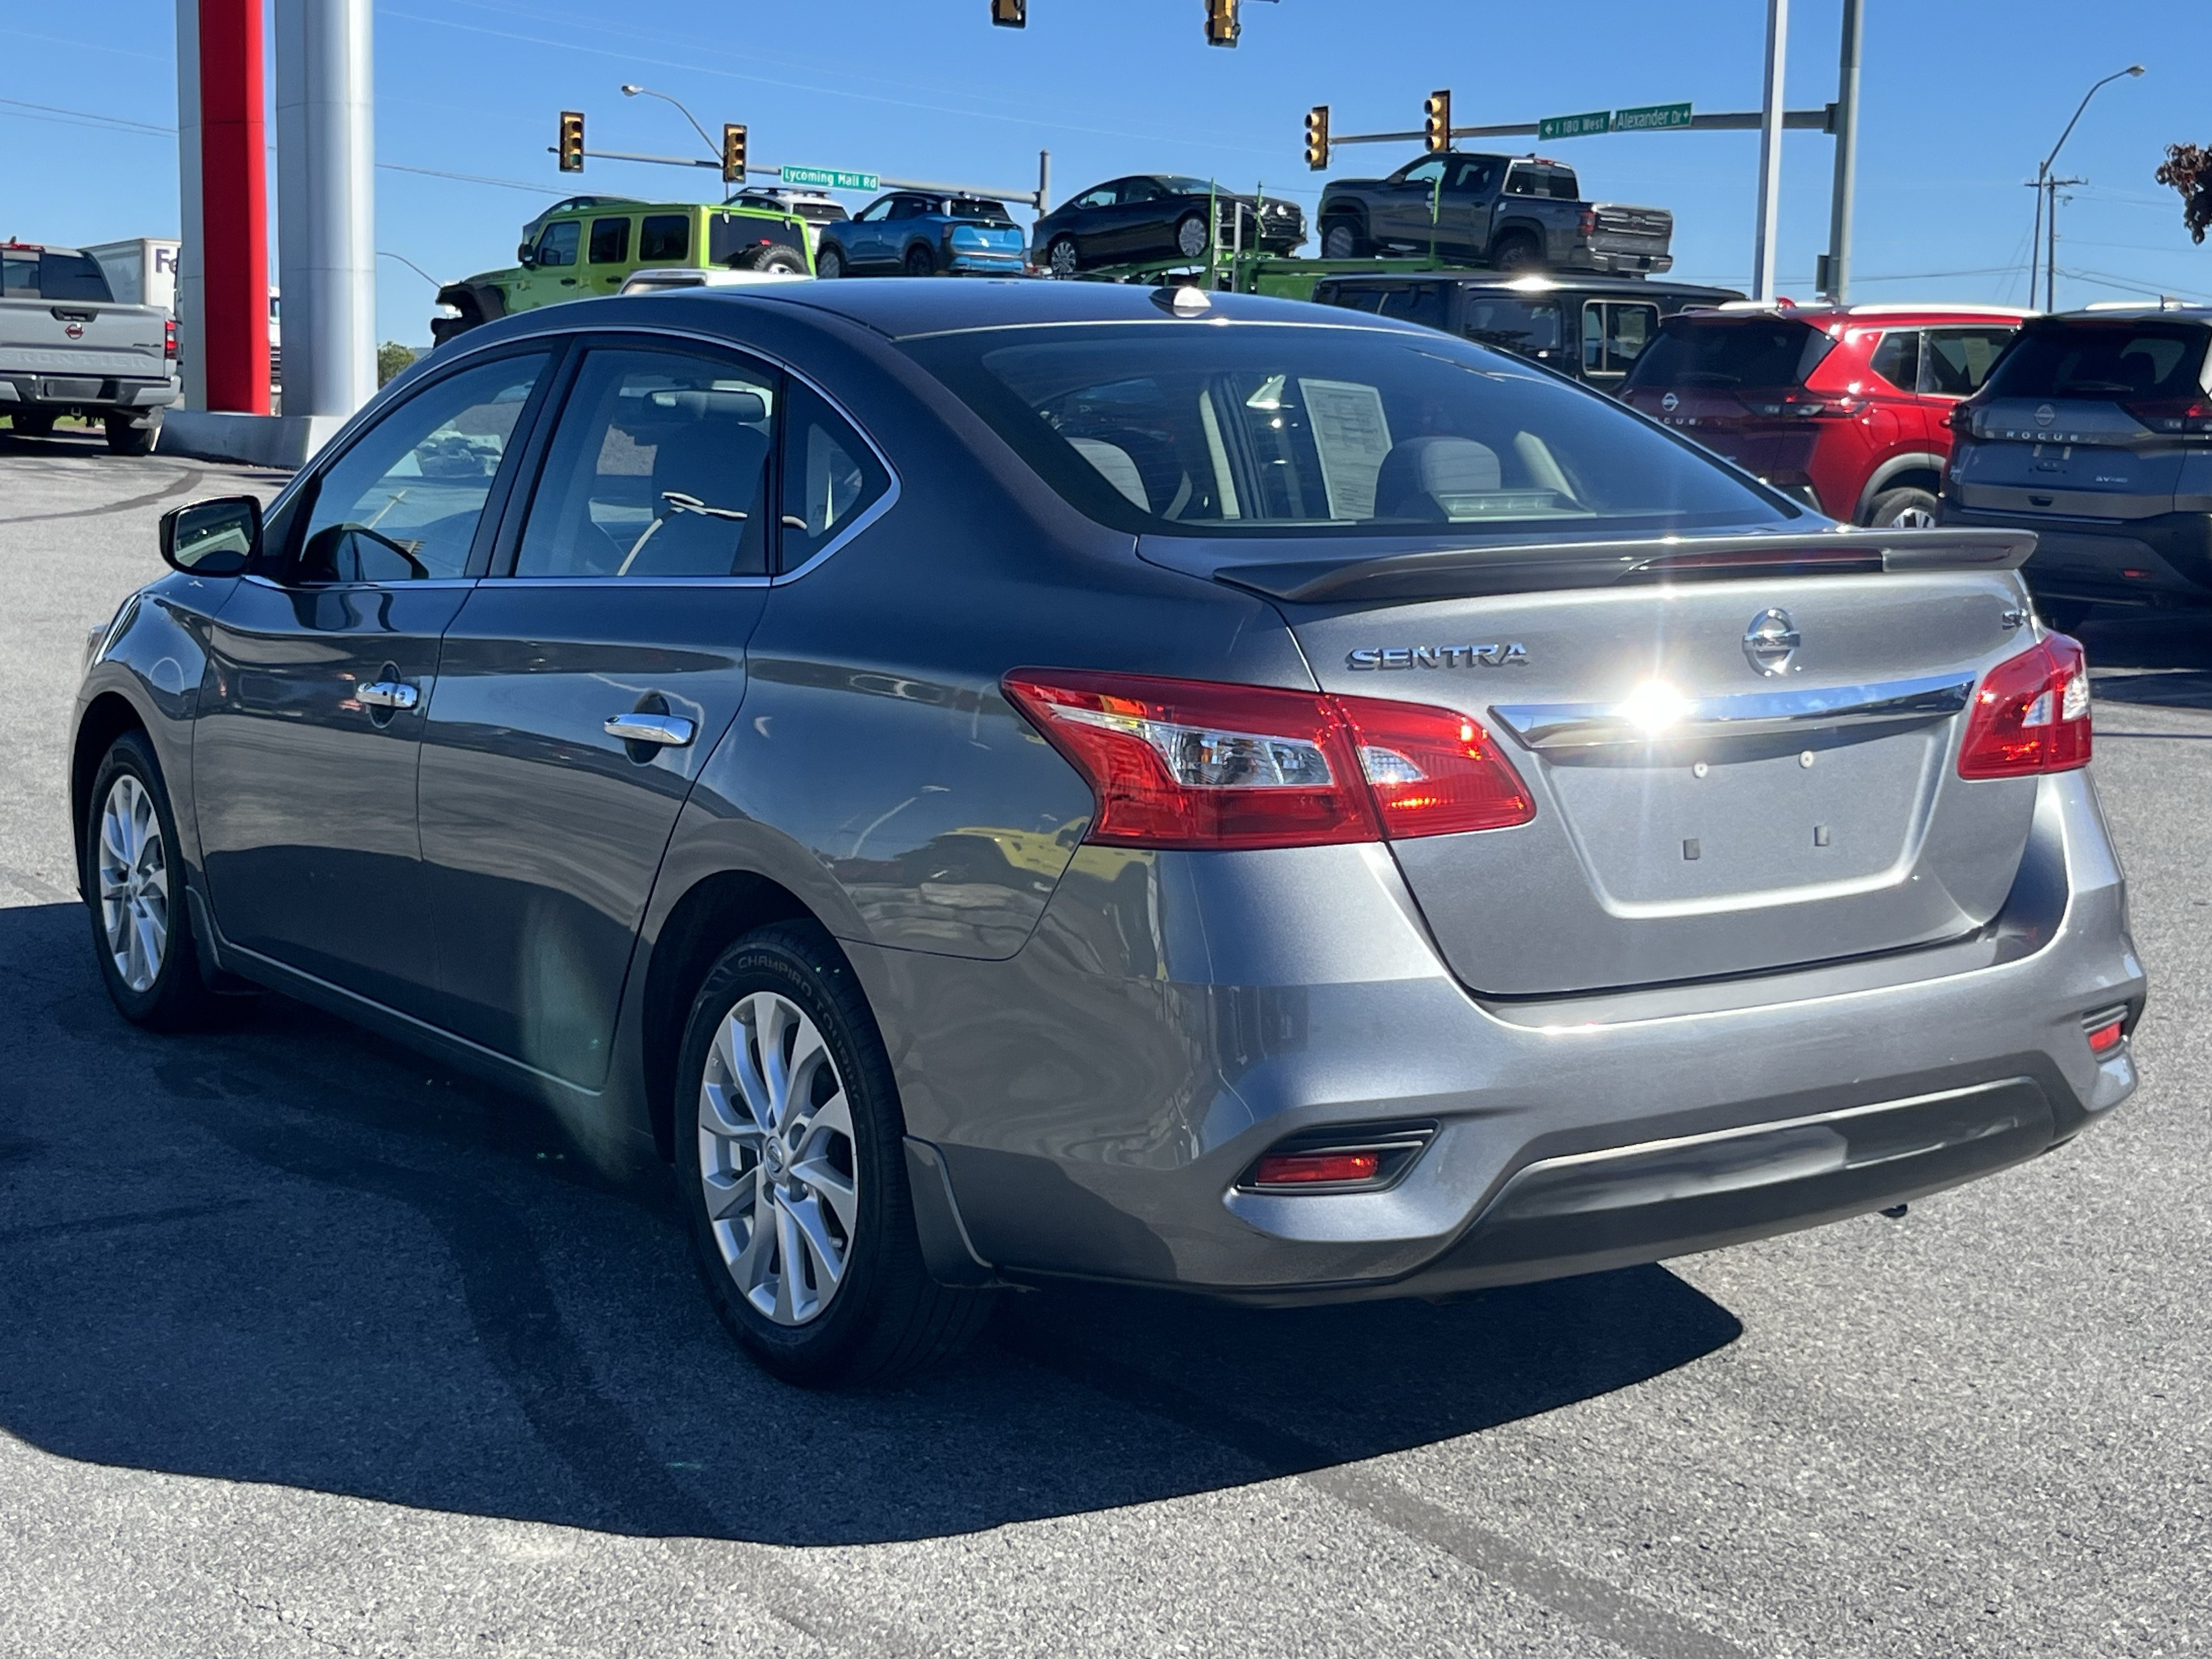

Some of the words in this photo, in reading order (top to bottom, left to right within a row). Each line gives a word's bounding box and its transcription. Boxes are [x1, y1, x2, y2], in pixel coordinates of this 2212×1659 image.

[1563, 120, 1579, 133] 180
[1582, 117, 1604, 132] West
[1617, 109, 1669, 129] Alexander
[1671, 111, 1682, 125] Dr
[785, 168, 834, 187] Lycoming
[838, 173, 860, 187] Mall
[864, 176, 877, 189] Rd
[2006, 431, 2079, 442] ROGUE
[1345, 642, 1530, 671] SENTRA
[738, 955, 812, 997] CHAMPIRO
